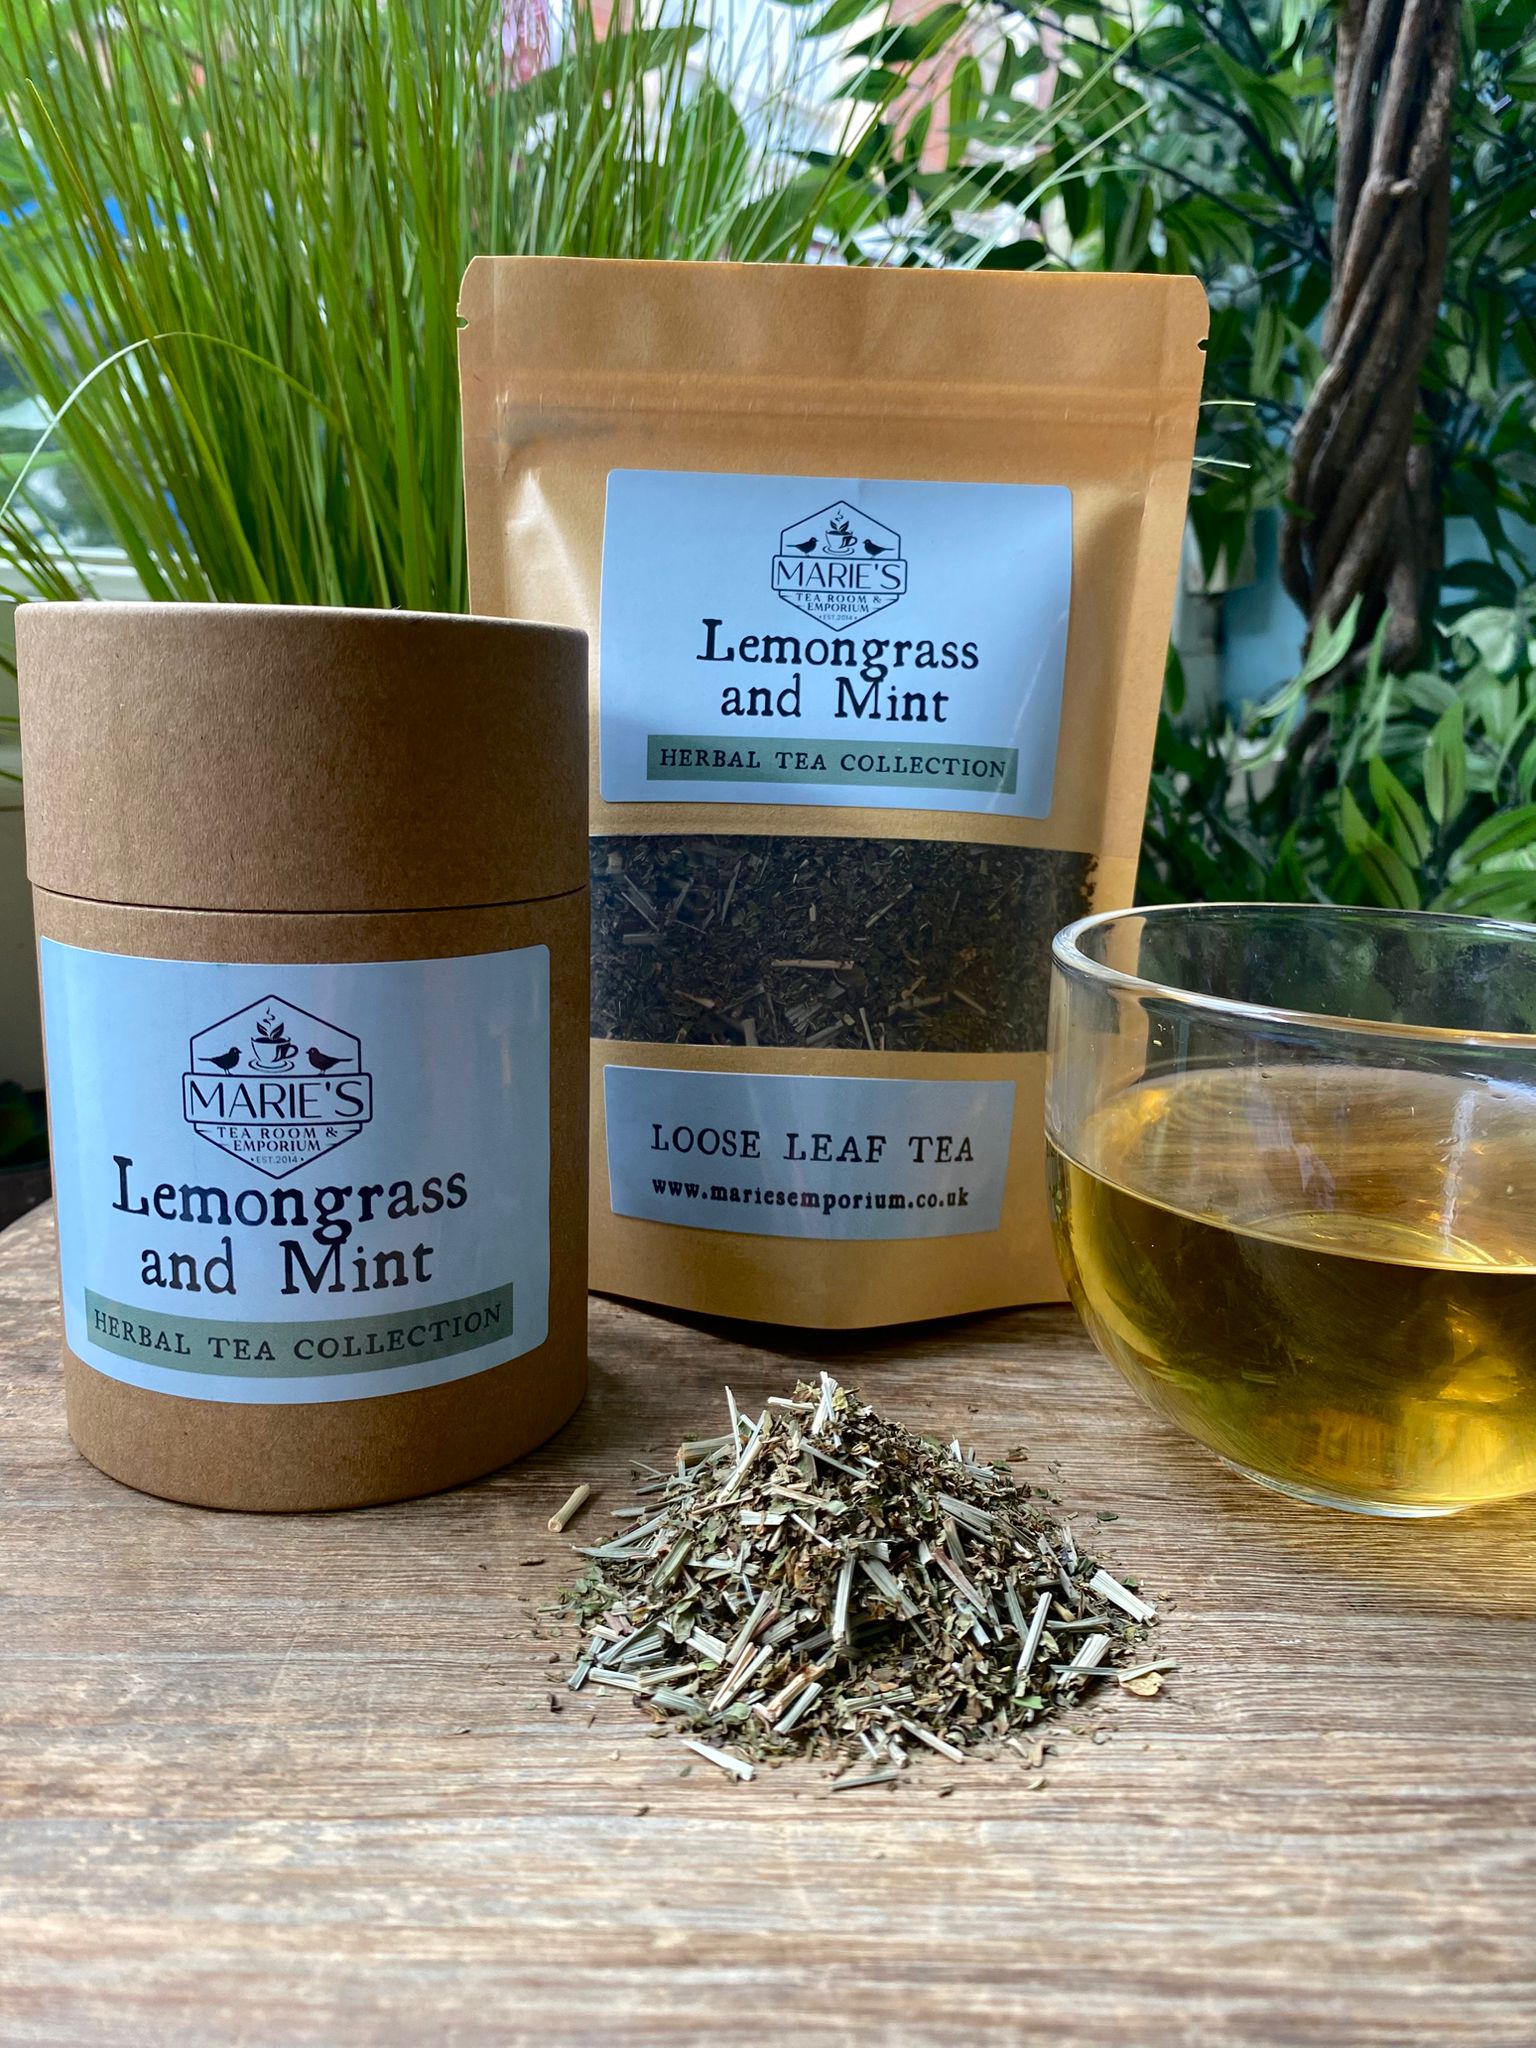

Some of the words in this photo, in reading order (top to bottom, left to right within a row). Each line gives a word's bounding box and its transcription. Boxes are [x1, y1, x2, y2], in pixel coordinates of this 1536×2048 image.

[777, 561, 901, 590] MARIE'S
[796, 593, 820, 603] TEA
[827, 594, 867, 604] ROOM
[872, 596, 882, 604] &
[807, 602, 870, 613] EMPORIUM
[696, 618, 979, 682] Lemongrass
[721, 673, 801, 717] and
[834, 677, 949, 723] Mint
[660, 748, 761, 769] HERBAL
[776, 751, 827, 771] TEA
[840, 754, 1006, 778] COLLECTION
[190, 1080, 364, 1119] MARIE'S
[217, 1126, 251, 1139] TEA
[260, 1127, 316, 1139] ROOM
[325, 1127, 338, 1138] &
[233, 1140, 321, 1152] EMPORIUM
[651, 1124, 760, 1158] LOOSE
[783, 1133, 887, 1163] LEAF
[908, 1136, 973, 1163] TEA
[112, 1155, 468, 1246] Lemongrass
[652, 1178, 969, 1215] www.mariesemporium.co.uk
[141, 1237, 236, 1295] and
[279, 1239, 434, 1295] Mint
[94, 1308, 191, 1355] HERBAL
[208, 1335, 276, 1361] TEA
[293, 1304, 501, 1361] COLLECTION
